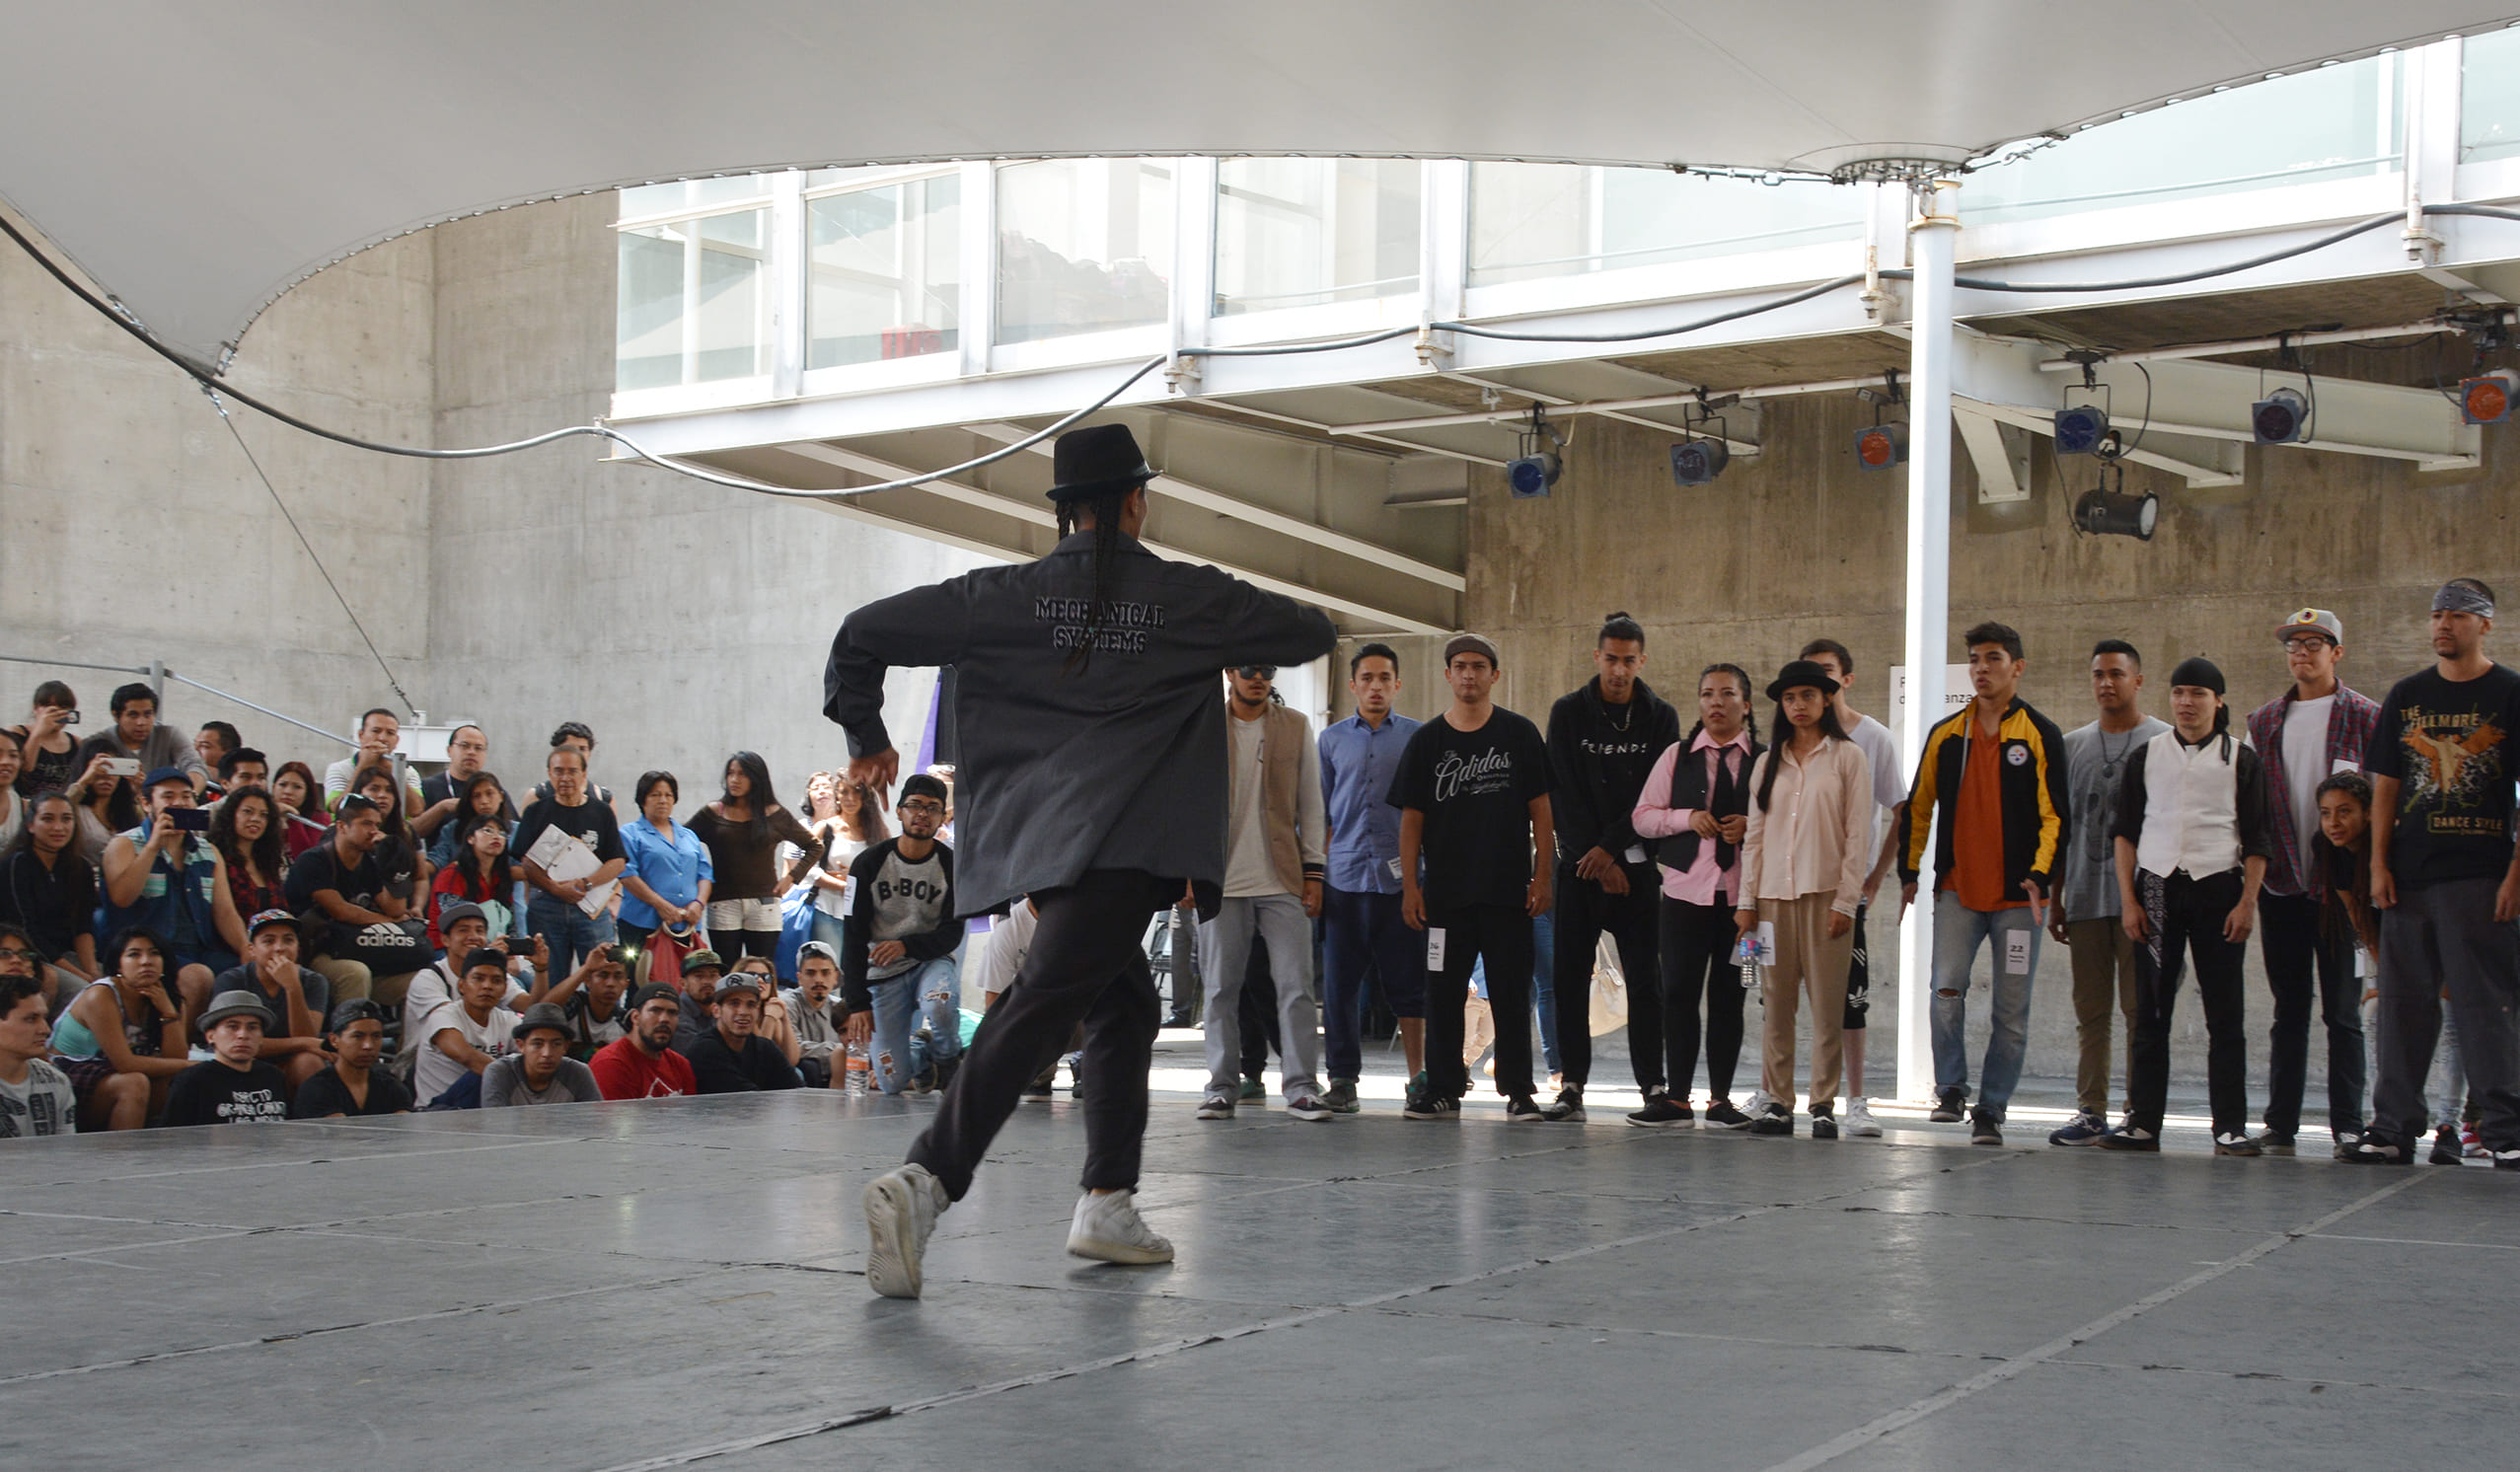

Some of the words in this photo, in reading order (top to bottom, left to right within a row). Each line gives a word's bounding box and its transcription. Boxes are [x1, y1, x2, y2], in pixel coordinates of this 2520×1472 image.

[2400, 704, 2420, 721] THE
[2411, 712, 2481, 729] FILLMORE
[2433, 816, 2471, 829] DANCE
[2475, 817, 2503, 831] STYLE
[877, 877, 941, 905] B-BOY
[355, 932, 416, 947] adidas
[2010, 944, 2024, 953] 22
